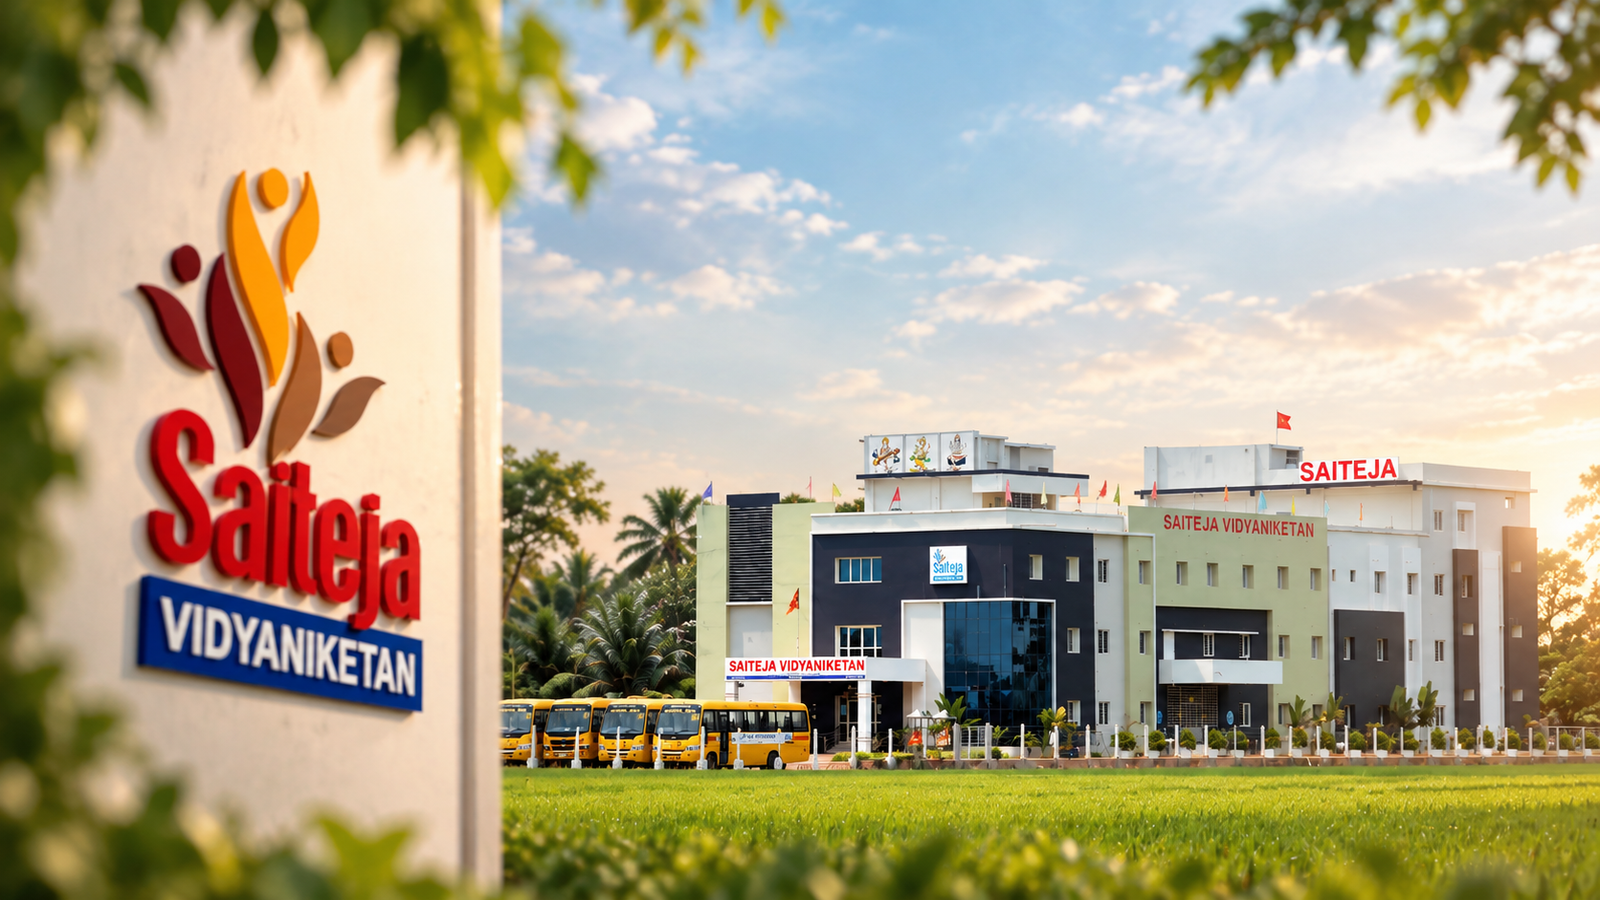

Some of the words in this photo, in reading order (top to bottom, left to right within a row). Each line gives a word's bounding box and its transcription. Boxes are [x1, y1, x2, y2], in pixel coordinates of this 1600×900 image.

[1300, 458, 1397, 482] SAITEJA
[147, 408, 420, 630] Saiteja
[1163, 514, 1219, 532] SAITEJA
[1222, 517, 1314, 538] VIDYANIKETAN
[160, 596, 416, 697] VIDYANIKETAN
[729, 660, 776, 672] SAITEJA
[780, 659, 865, 672] VIDYANIKETAN
